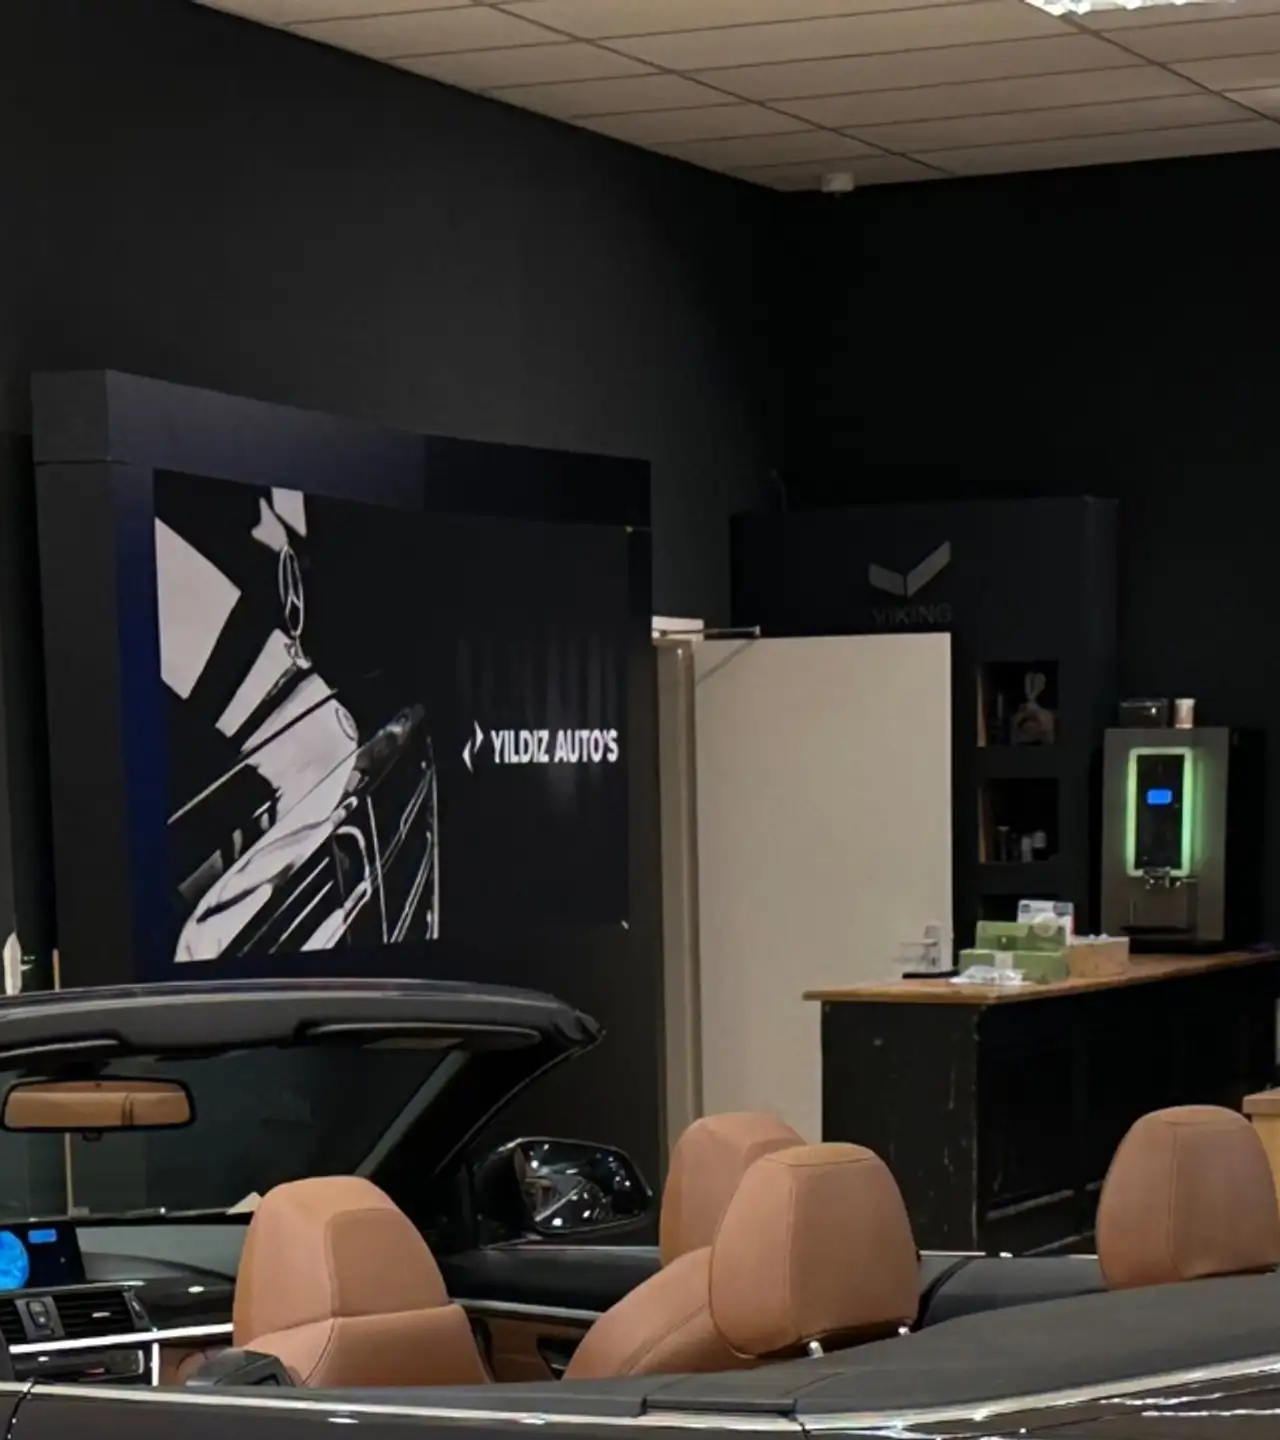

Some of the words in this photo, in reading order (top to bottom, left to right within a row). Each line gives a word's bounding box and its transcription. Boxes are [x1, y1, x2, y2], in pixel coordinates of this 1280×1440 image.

[871, 602, 952, 625] VIKING
[490, 729, 550, 763] YILDIZ
[554, 728, 619, 763] AUTO'S
